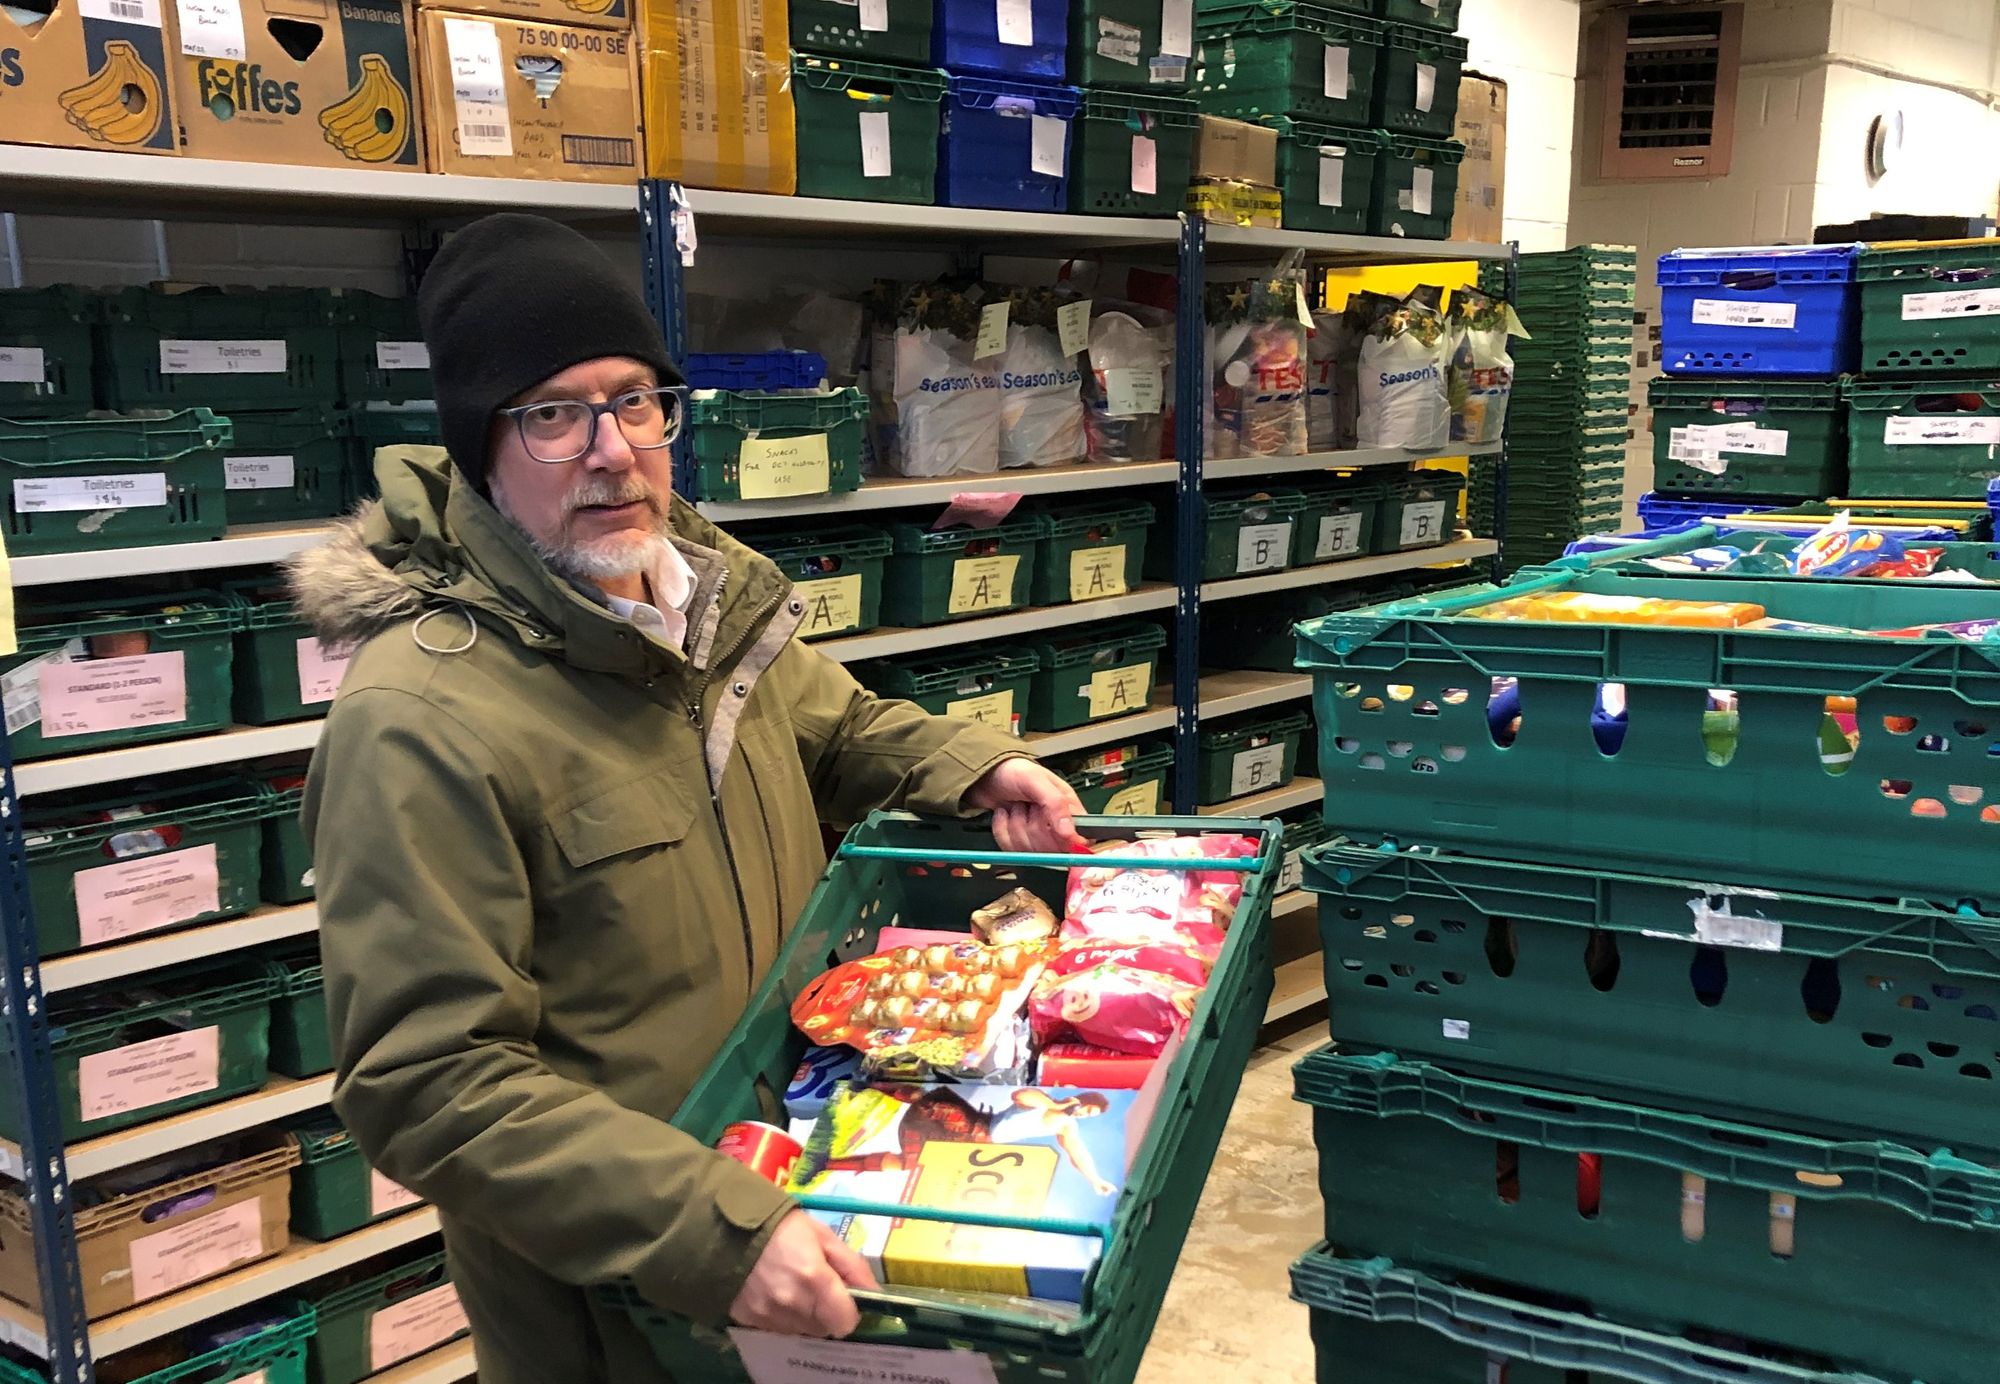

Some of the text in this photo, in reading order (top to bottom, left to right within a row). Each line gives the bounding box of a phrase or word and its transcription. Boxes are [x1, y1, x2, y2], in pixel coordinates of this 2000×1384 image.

[342, 3, 401, 25] Bananas
[516, 27, 626, 55] 75 90 00-00 SE
[218, 346, 261, 357] Toiletries
[919, 372, 980, 393] Season's
[1003, 369, 1065, 389] Season's
[1256, 367, 1302, 391] TES
[1380, 364, 1438, 387] Season's
[227, 463, 269, 472] Toiletries
[83, 479, 135, 491] Toiletries
[1416, 515, 1429, 538] B
[1332, 528, 1343, 551] B
[1256, 539, 1269, 565] B
[971, 575, 988, 606] A
[1089, 564, 1104, 594] A
[811, 594, 832, 629] A
[67, 682, 112, 693] STANDARD
[129, 676, 162, 687] PERSON)
[1111, 679, 1126, 708] A
[1250, 761, 1263, 785] B
[1282, 863, 1292, 887] B
[103, 884, 146, 899] STANDARD
[1074, 952, 1086, 964] 6
